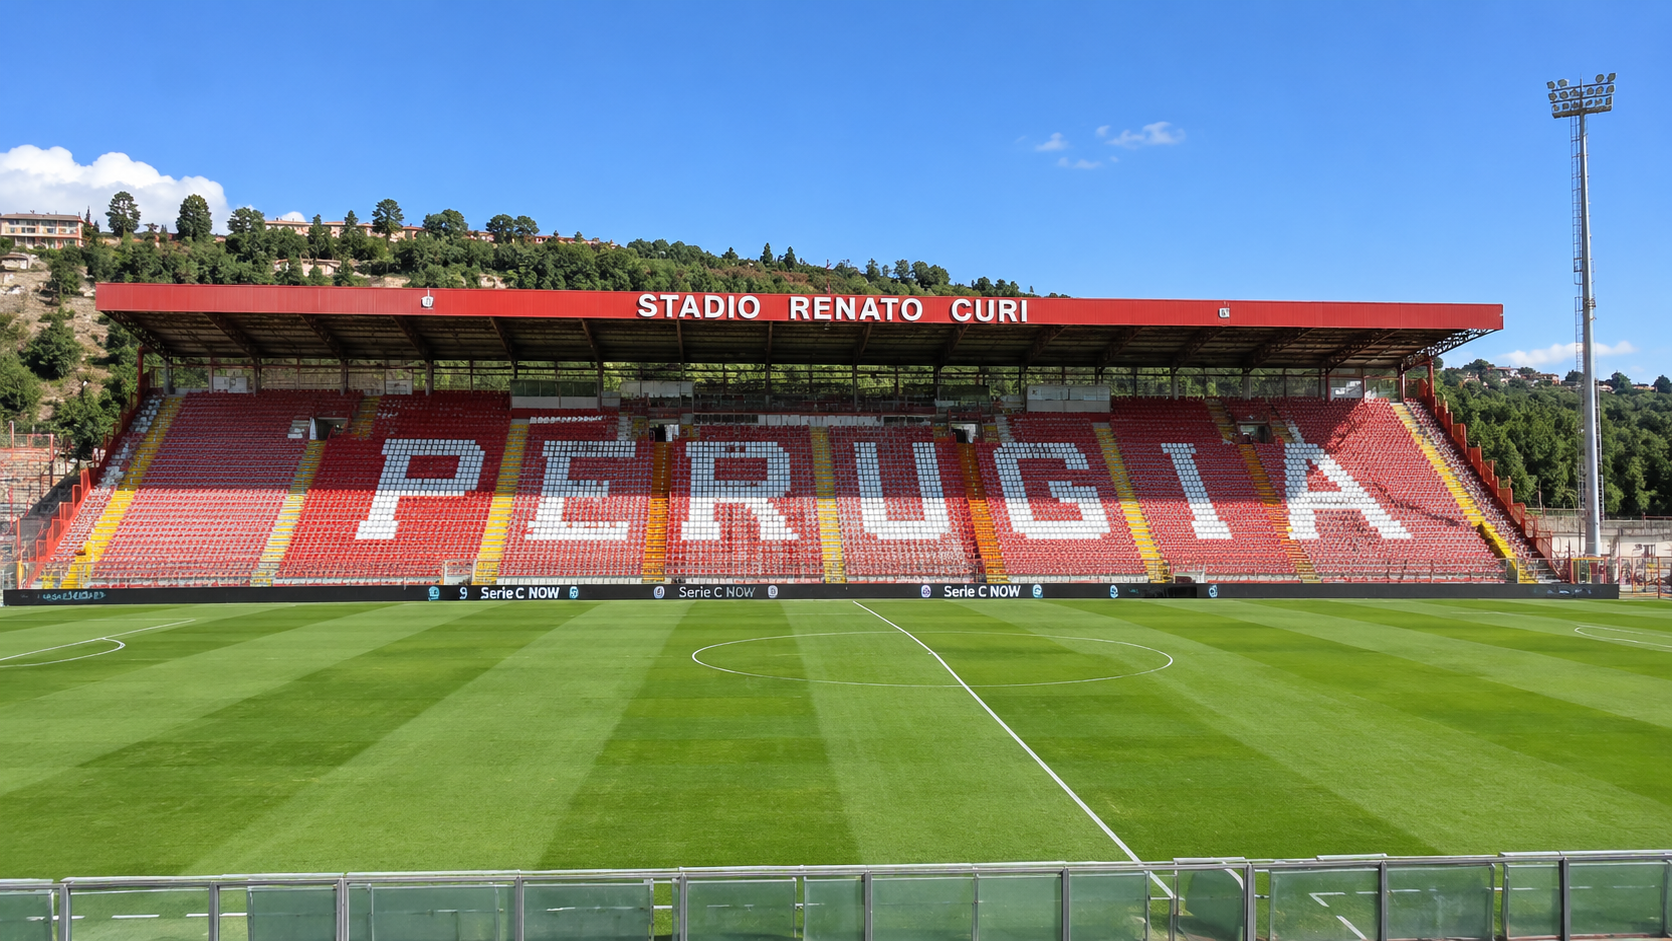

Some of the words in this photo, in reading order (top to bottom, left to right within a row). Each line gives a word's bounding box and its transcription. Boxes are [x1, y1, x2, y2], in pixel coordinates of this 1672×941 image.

[637, 293, 761, 320] STADIO
[789, 296, 924, 322] RENATO
[950, 298, 1028, 323] CURI
[355, 438, 1411, 541] PERUGIA
[480, 586, 514, 599] Serie
[515, 586, 525, 599] C
[528, 586, 560, 599] NOW
[679, 586, 711, 598] Serie
[713, 586, 723, 598] C
[726, 586, 756, 598] NOW
[978, 585, 988, 597] C
[990, 585, 1021, 597] NOW
